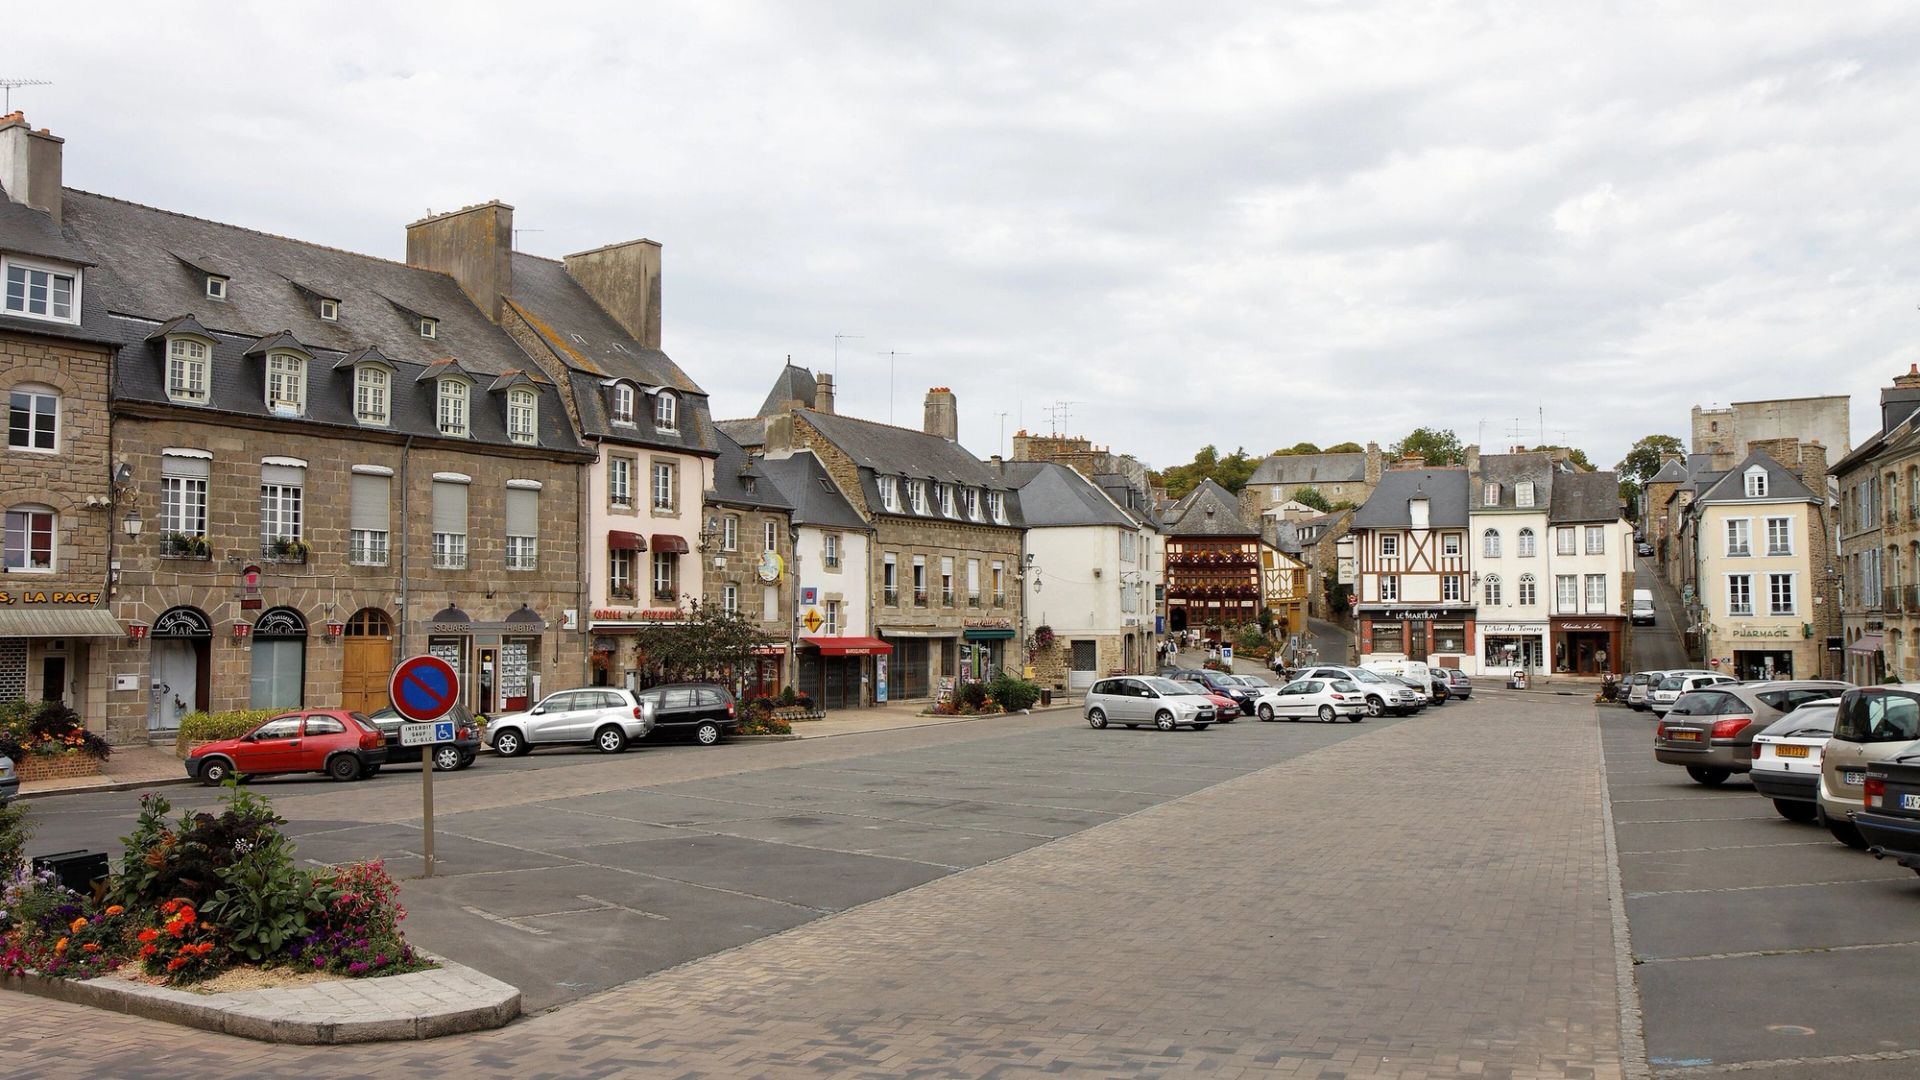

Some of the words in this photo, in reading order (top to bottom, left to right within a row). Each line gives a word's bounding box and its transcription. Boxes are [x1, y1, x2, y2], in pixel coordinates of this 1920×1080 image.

[24, 591, 47, 604] LA
[52, 591, 100, 604] PAGE
[593, 609, 621, 620] GRILL
[1395, 612, 1404, 620] LE
[1405, 611, 1438, 620] MARTRAY
[170, 625, 193, 636] BAR
[435, 623, 471, 634] SQUARE
[506, 623, 538, 633] HABITAT
[1504, 624, 1515, 632] du
[1519, 624, 1543, 633] Temps
[1732, 629, 1790, 639] PHARMACIE
[405, 724, 432, 732] INTERDIT
